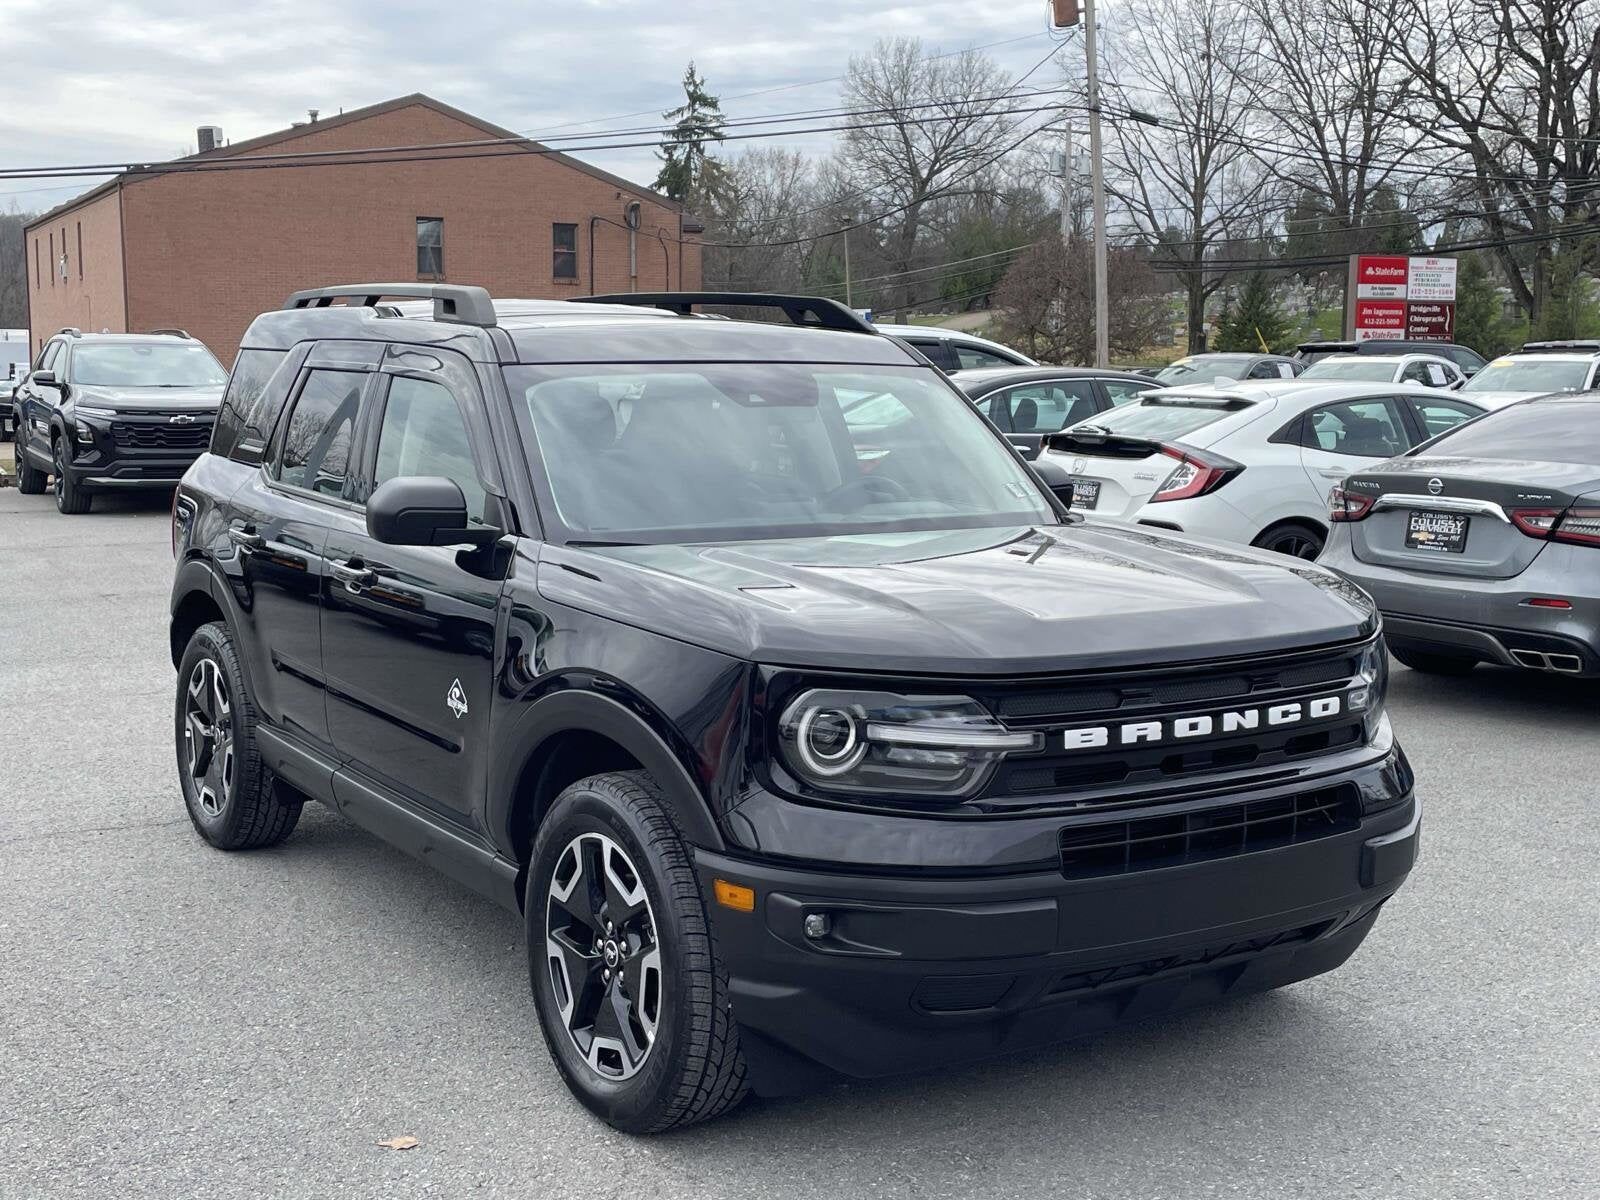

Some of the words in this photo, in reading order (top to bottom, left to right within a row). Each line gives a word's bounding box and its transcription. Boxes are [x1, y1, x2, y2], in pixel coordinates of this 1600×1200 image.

[1362, 307, 1373, 315] Jim
[1410, 305, 1441, 313] Bridgeville
[1410, 315, 1445, 323] Chiropractic
[1410, 325, 1429, 333] Center
[1411, 517, 1464, 529] COLUSSY
[1410, 524, 1463, 534] CHEVROLET
[1064, 696, 1340, 750] BRONCO
